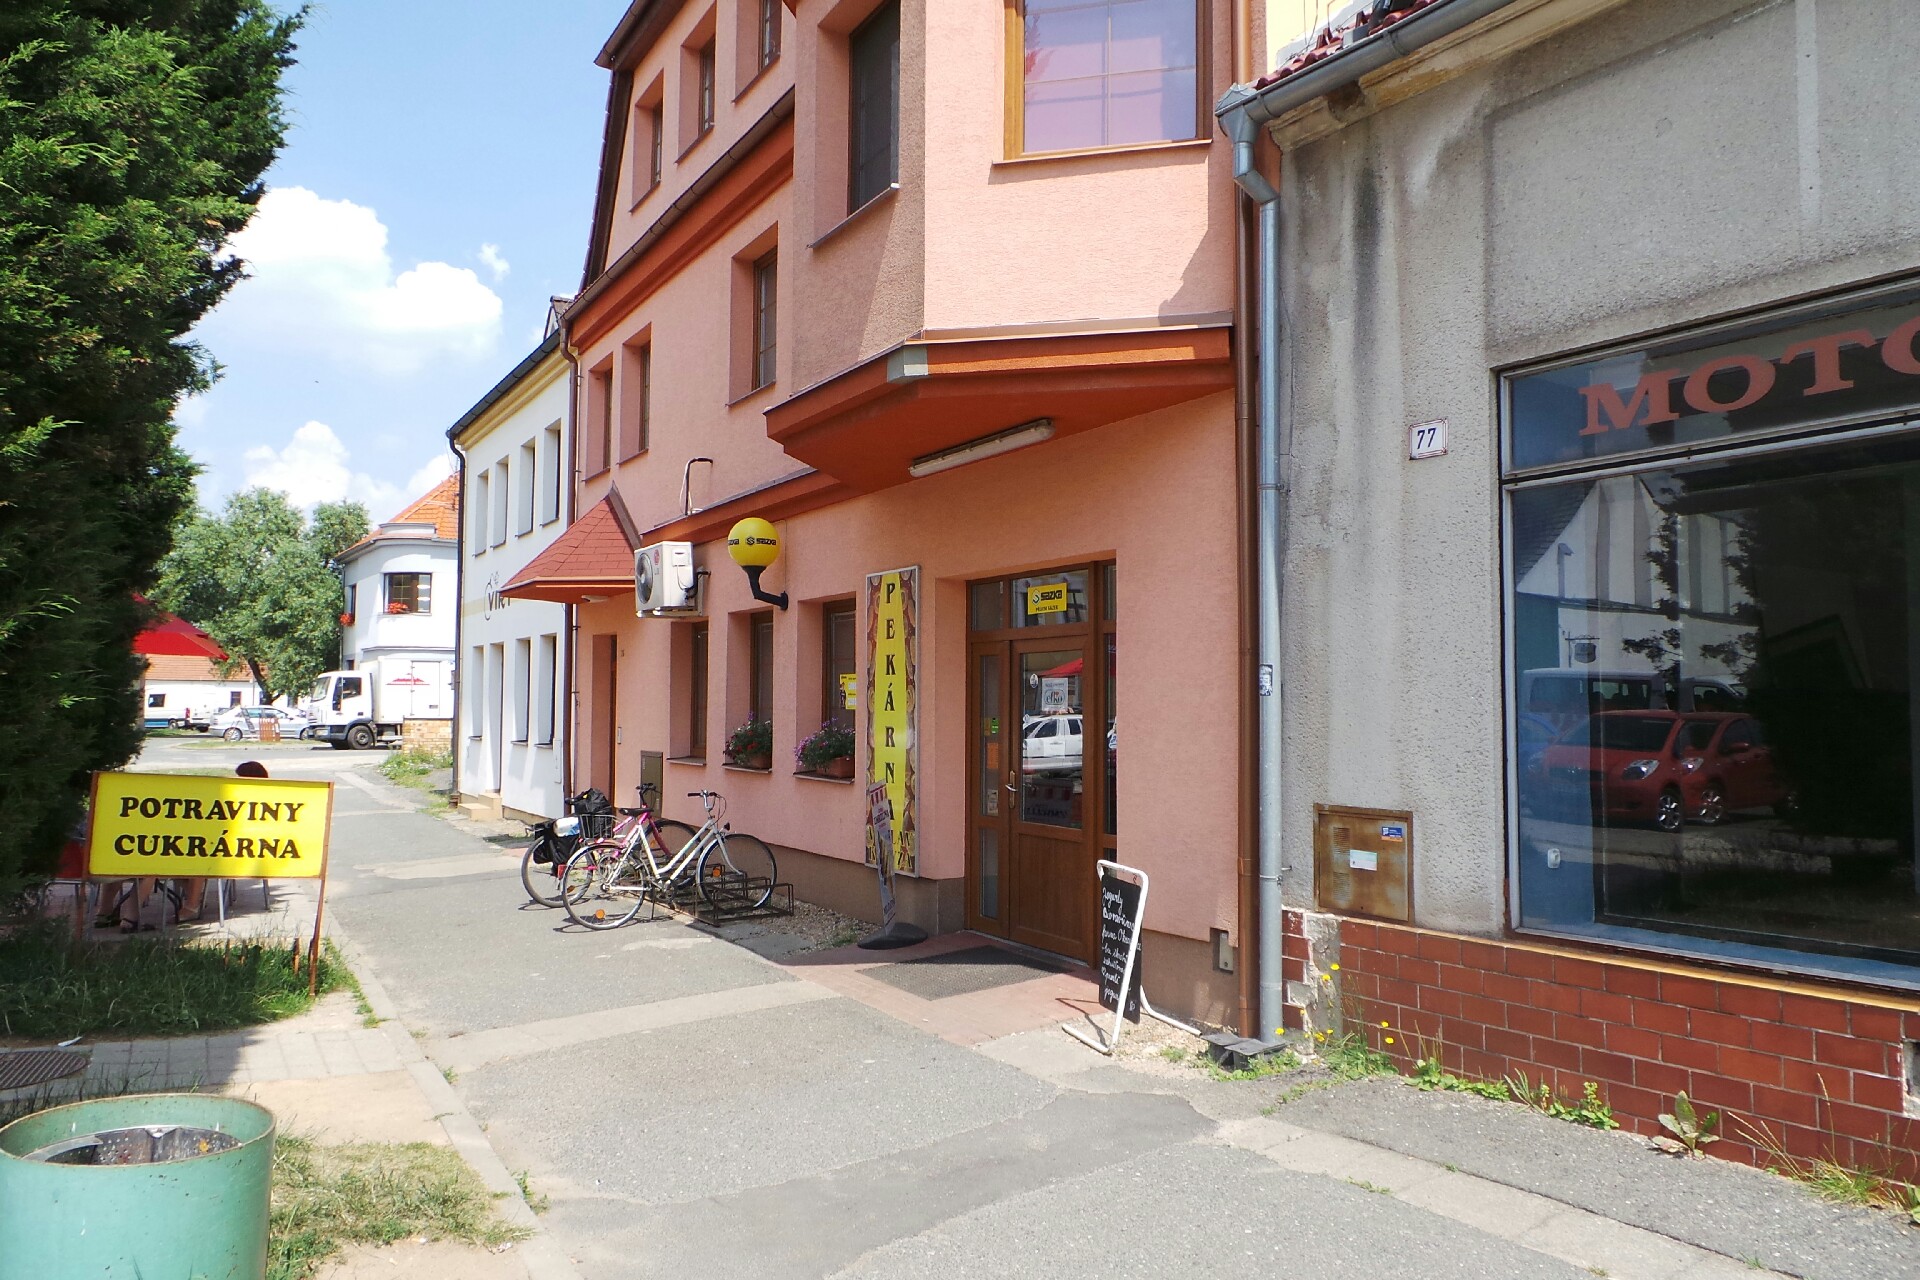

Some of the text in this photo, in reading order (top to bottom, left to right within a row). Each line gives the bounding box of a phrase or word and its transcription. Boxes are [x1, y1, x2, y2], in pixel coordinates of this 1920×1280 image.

[1417, 427, 1437, 450] 77
[119, 796, 304, 822] POTRAVINY
[114, 830, 301, 859] CUKRÁRNA
